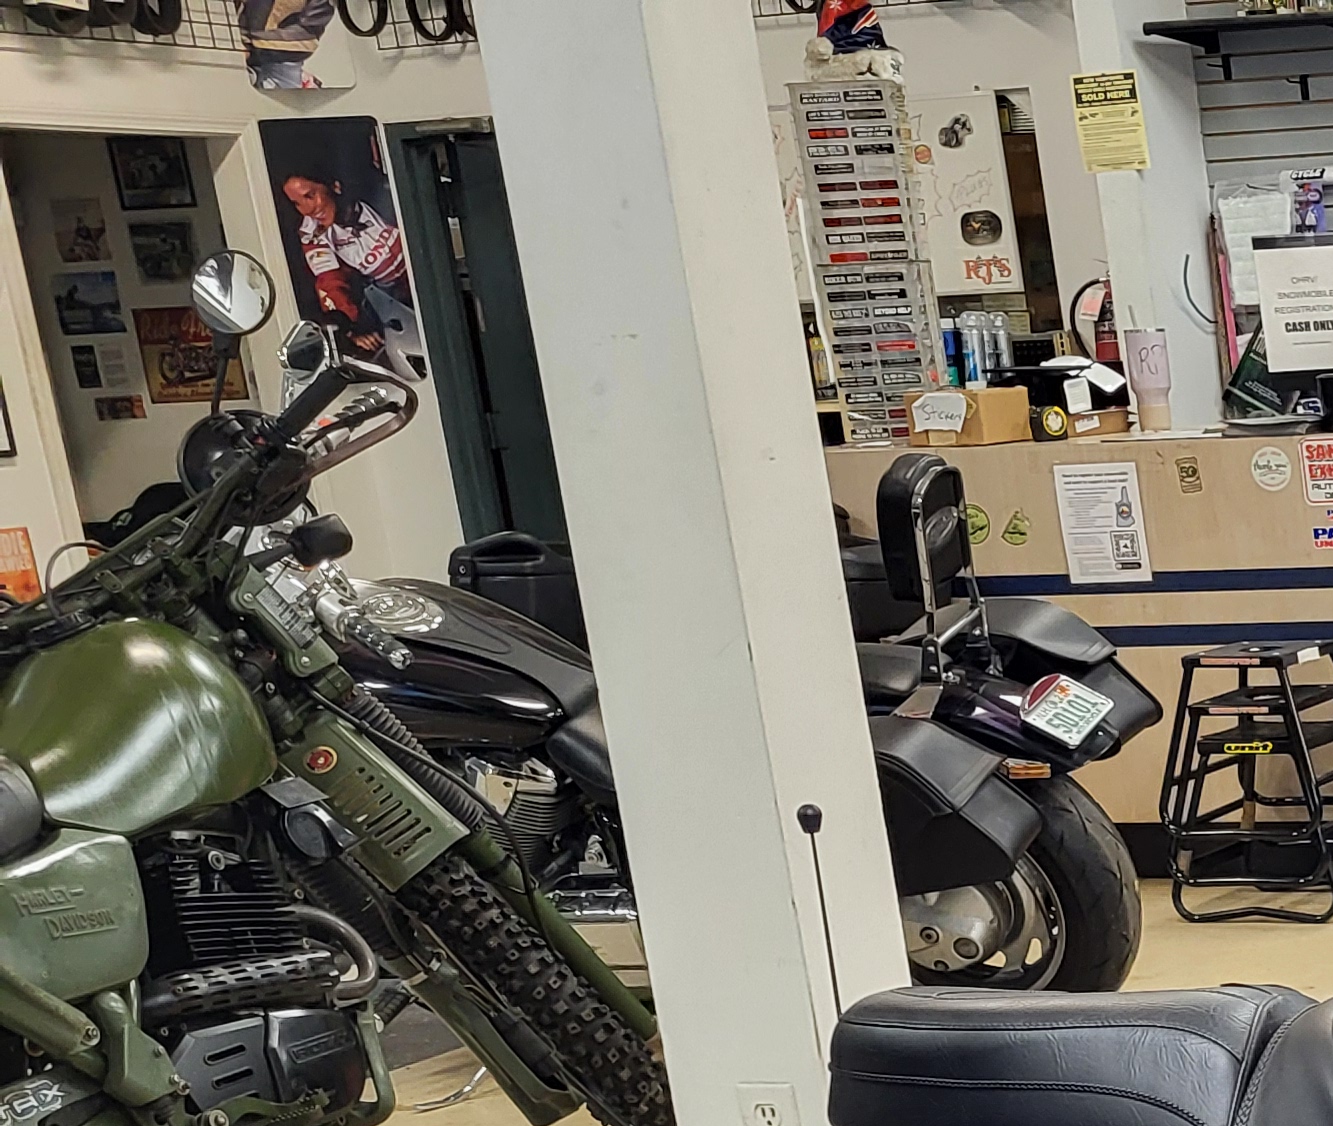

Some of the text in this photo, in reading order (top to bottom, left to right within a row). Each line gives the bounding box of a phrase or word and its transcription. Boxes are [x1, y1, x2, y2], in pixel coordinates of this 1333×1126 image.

[1081, 92, 1105, 102] SOLD
[1284, 321, 1311, 333] CASH
[44, 909, 116, 941] DAVIDSON
